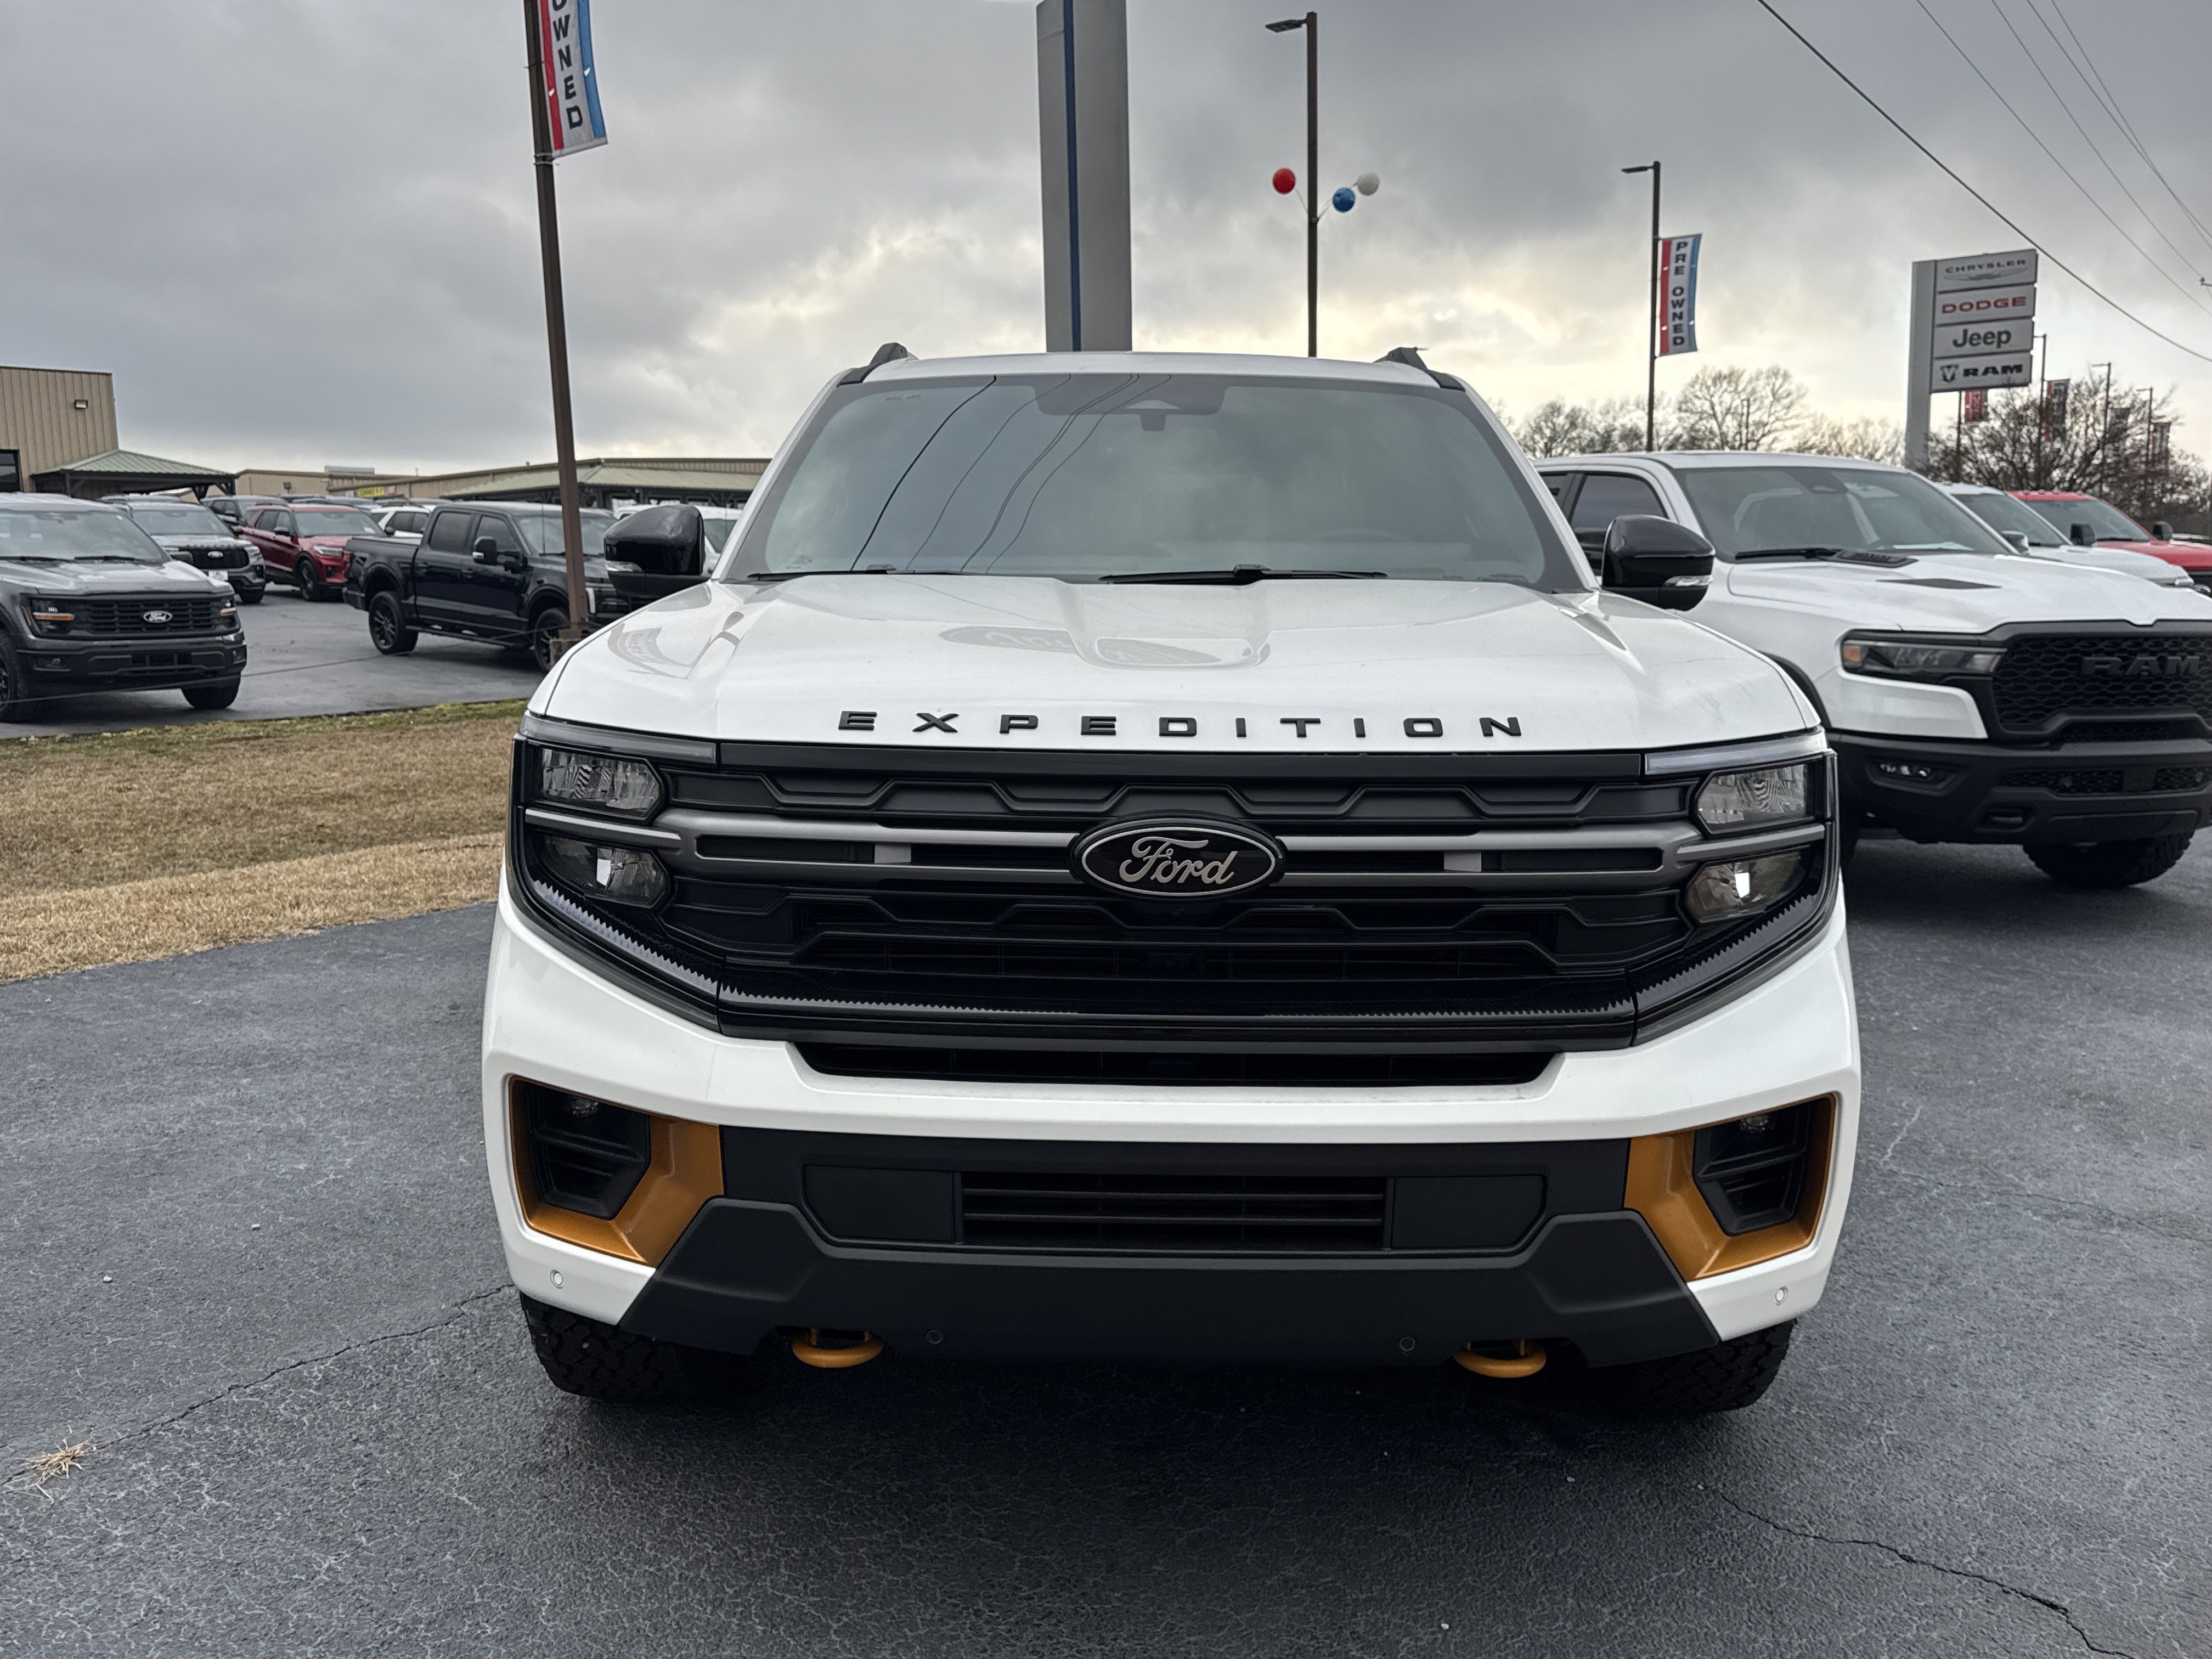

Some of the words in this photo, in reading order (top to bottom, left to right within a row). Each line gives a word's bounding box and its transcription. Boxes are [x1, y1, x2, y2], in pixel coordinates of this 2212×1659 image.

[1674, 241, 1688, 275] PRE
[1945, 258, 2027, 274] CHRYSLER
[1942, 296, 2027, 314] DODGE
[1671, 286, 1685, 346] OWNED
[1952, 329, 2012, 348] Jeep
[1962, 364, 2023, 378] RAM
[2082, 656, 2200, 675] RAM
[838, 710, 1522, 737] EXPEDITION
[1119, 836, 1238, 885] Ford
